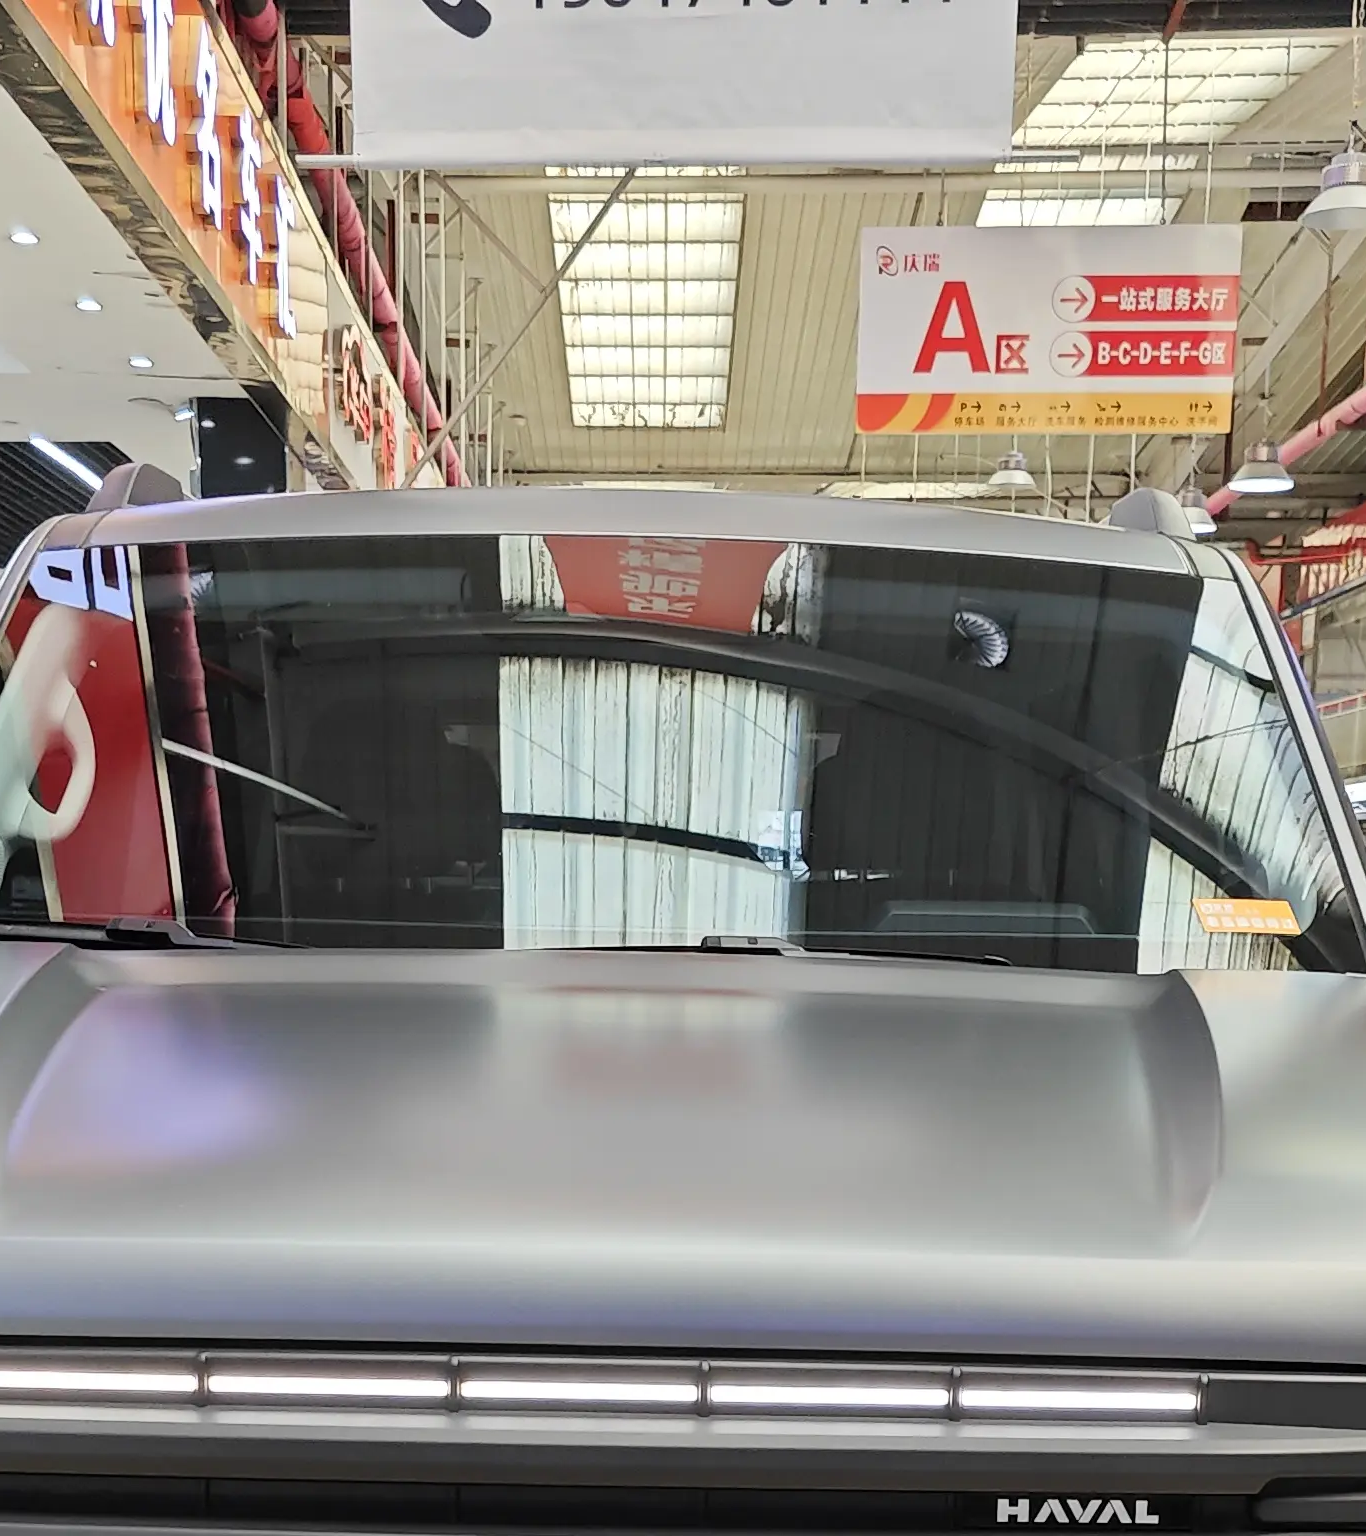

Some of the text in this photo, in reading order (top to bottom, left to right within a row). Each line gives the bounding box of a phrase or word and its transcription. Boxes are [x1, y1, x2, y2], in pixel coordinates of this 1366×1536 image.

[1100, 286, 1229, 312] 一站式服务大厅
[912, 280, 1030, 375] A区
[1096, 340, 1227, 366] B-C-D-E-F-G区
[996, 1498, 1160, 1525] HAVAL
